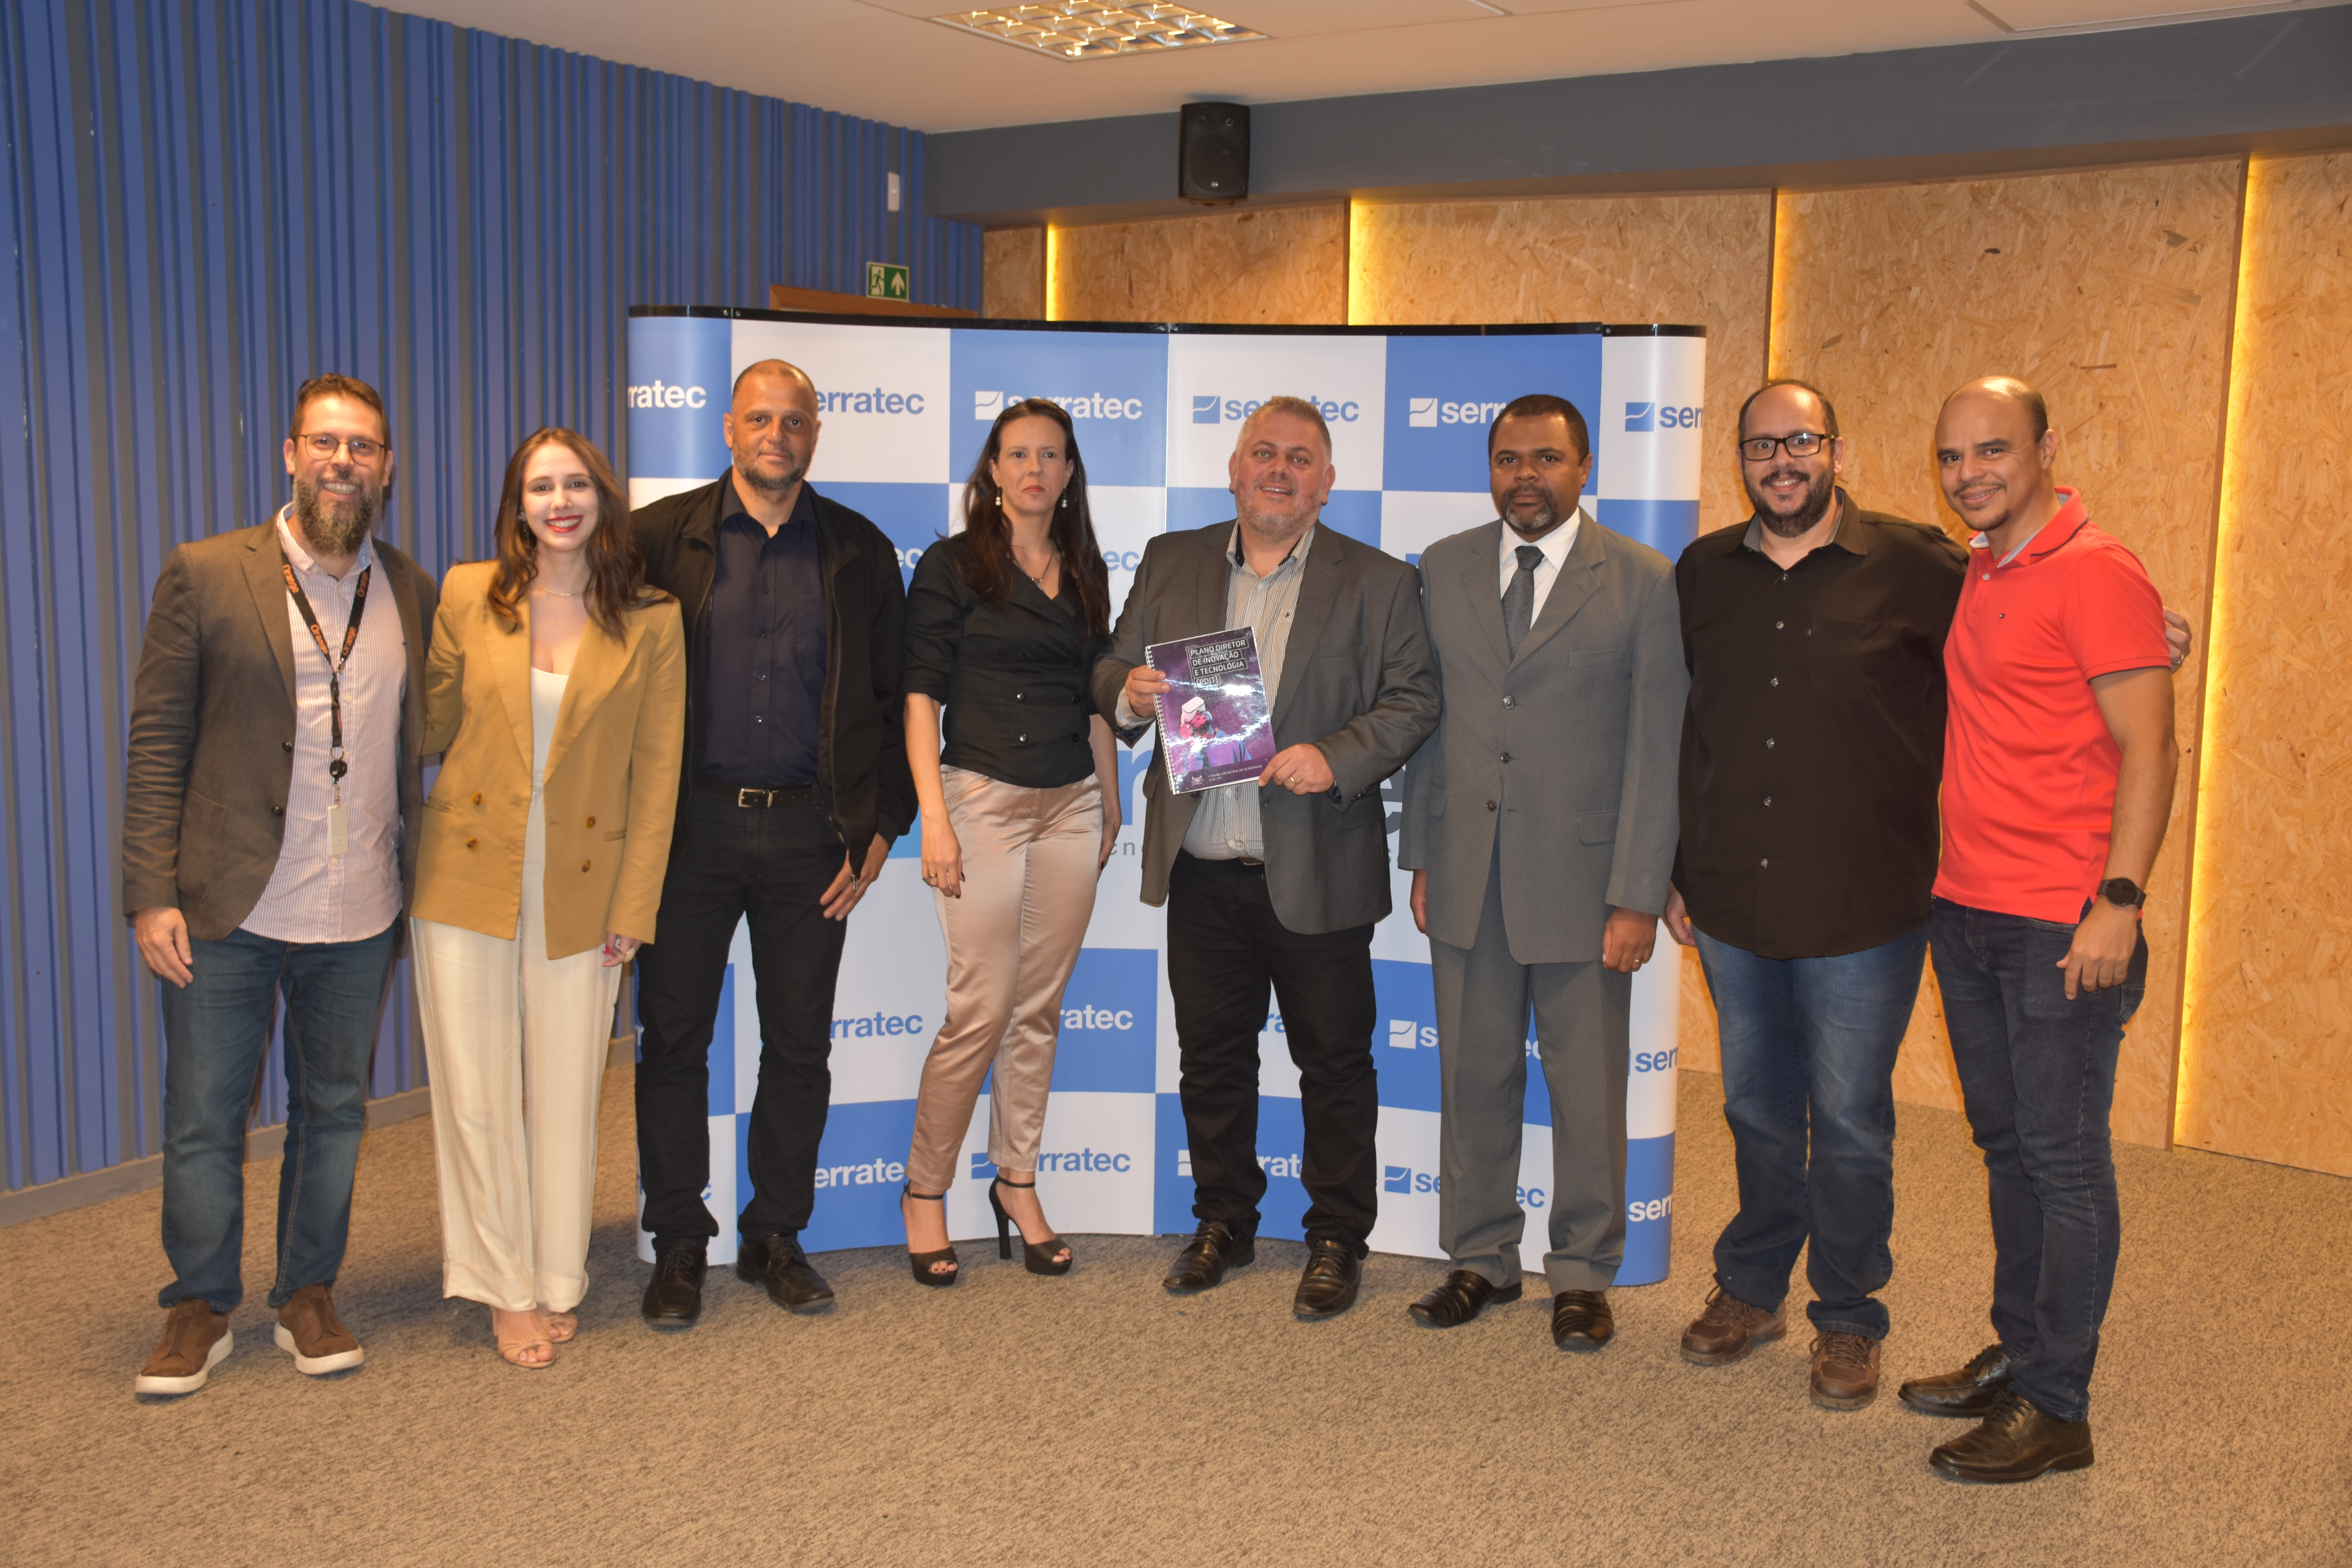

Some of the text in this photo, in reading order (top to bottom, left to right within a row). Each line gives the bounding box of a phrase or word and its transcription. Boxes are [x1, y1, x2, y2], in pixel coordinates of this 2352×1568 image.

[816, 387, 924, 414] erratec
[1441, 402, 1506, 424] serr
[283, 564, 299, 593] Orange
[357, 571, 368, 597] Orange
[310, 624, 328, 654] Orange
[343, 626, 356, 656] Orange
[1190, 639, 1246, 656] PLANO DIRETOR
[1200, 661, 1244, 675] TECNOLOGIA
[1203, 651, 1239, 664] INOVAÇÃO
[830, 1012, 923, 1039] rratec
[1038, 1148, 1131, 1172] rratec
[815, 1158, 904, 1189] errate
